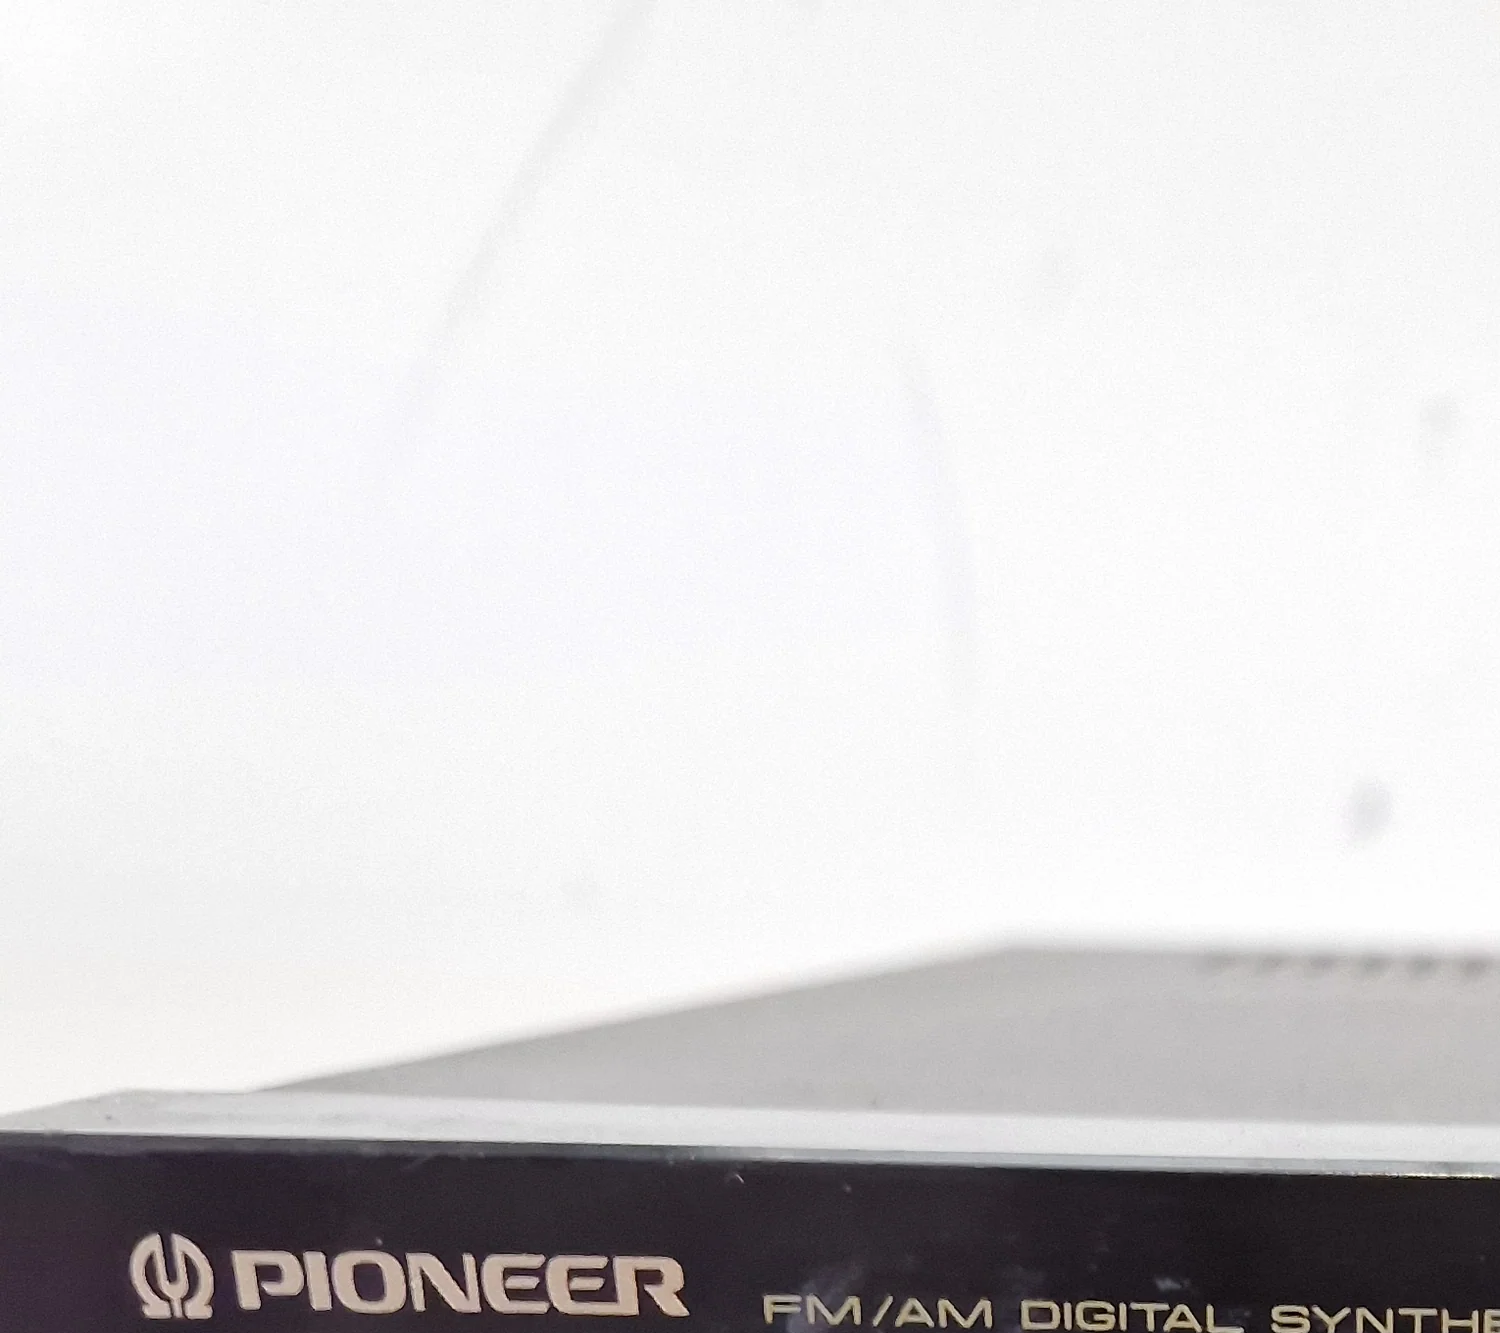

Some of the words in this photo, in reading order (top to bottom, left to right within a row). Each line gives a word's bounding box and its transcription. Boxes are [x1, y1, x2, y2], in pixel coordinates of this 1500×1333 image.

[231, 1249, 690, 1317] PIONEER
[762, 1292, 994, 1332] FM/AM
[1020, 1299, 1245, 1333] DIGITAL
